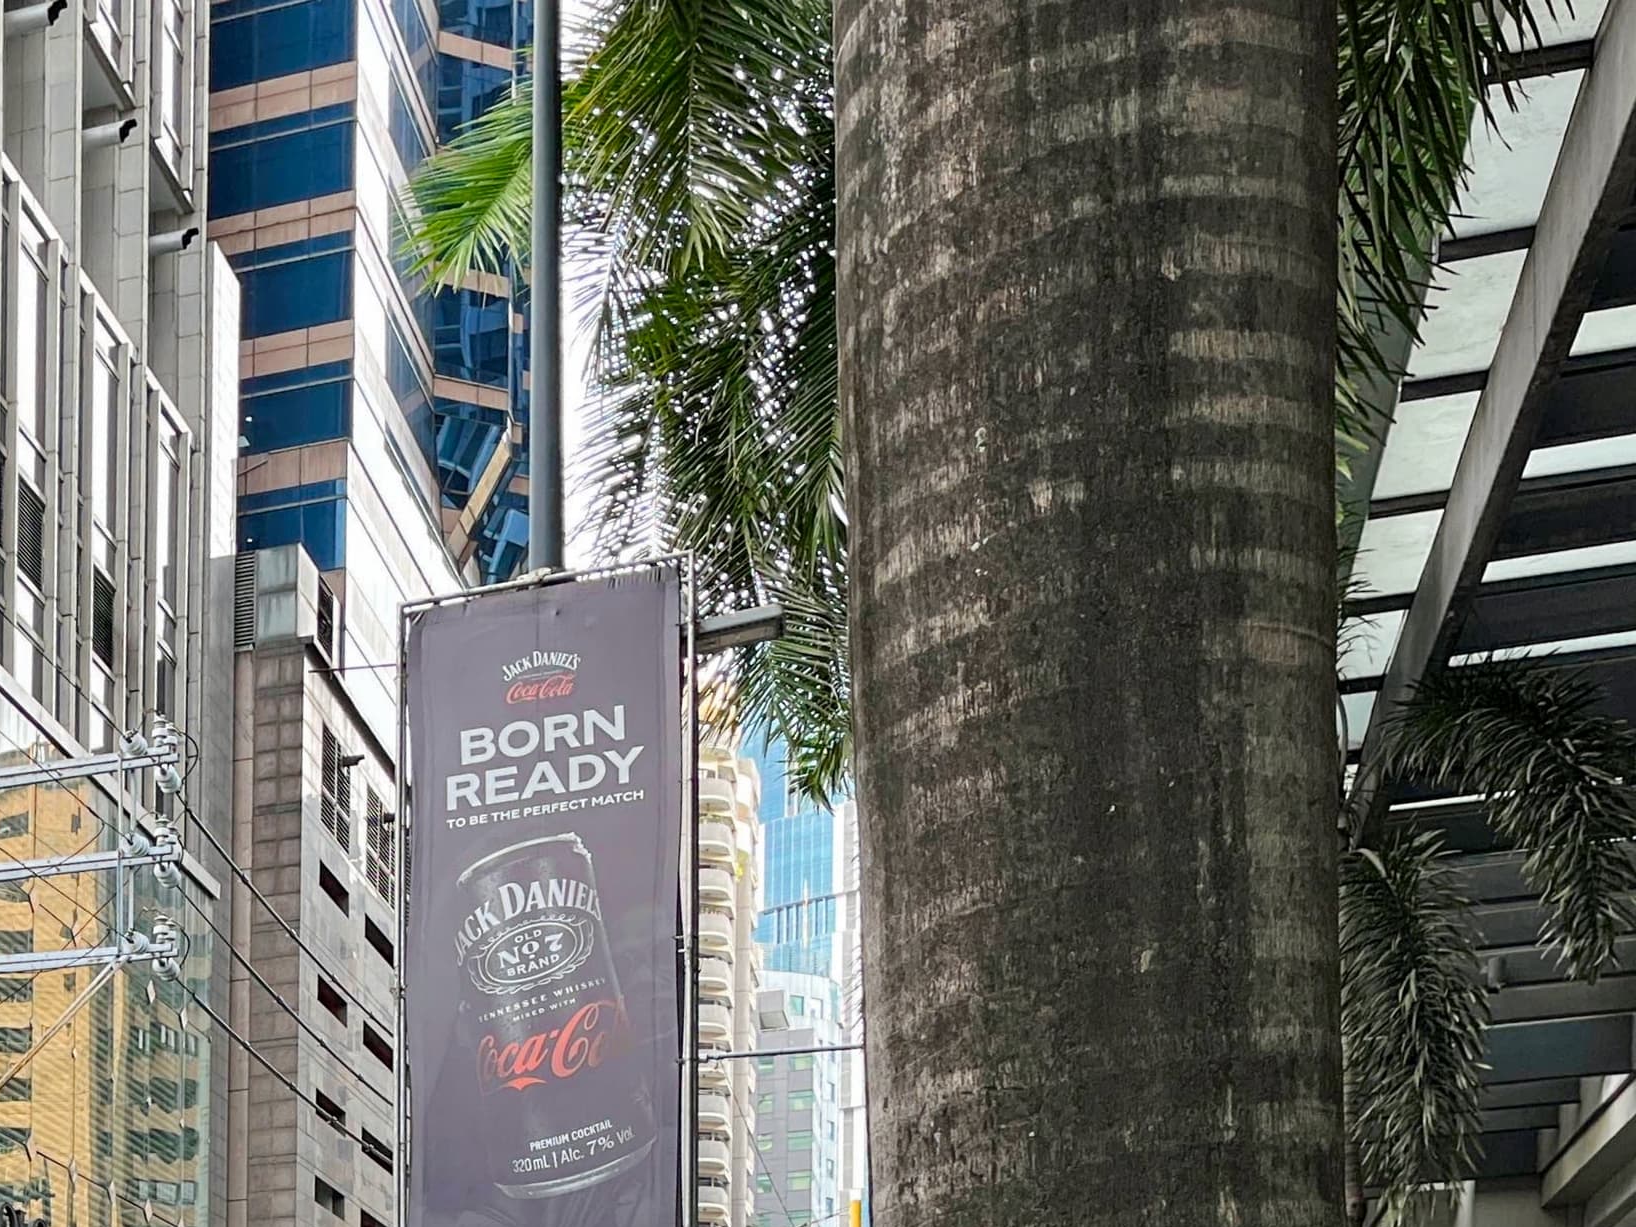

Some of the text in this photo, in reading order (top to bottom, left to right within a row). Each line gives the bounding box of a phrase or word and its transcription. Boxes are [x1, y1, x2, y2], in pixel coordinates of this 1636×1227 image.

[503, 656, 533, 681] JACK
[533, 651, 581, 670] DANIEL'S
[460, 705, 626, 766] BORN
[446, 746, 645, 811] READY
[446, 790, 645, 829] TO BE THE PERFECT MATCH
[454, 900, 501, 967] JACK
[514, 929, 543, 943] OLD
[507, 953, 560, 977] BRAND
[478, 977, 606, 1023] TENNESSEE WHISKEY
[513, 998, 576, 1022] MIXED WITH
[529, 1119, 613, 1152] PREMIUM COCKTAIL
[560, 1147, 585, 1165] Alc.
[586, 1135, 614, 1156] 7%
